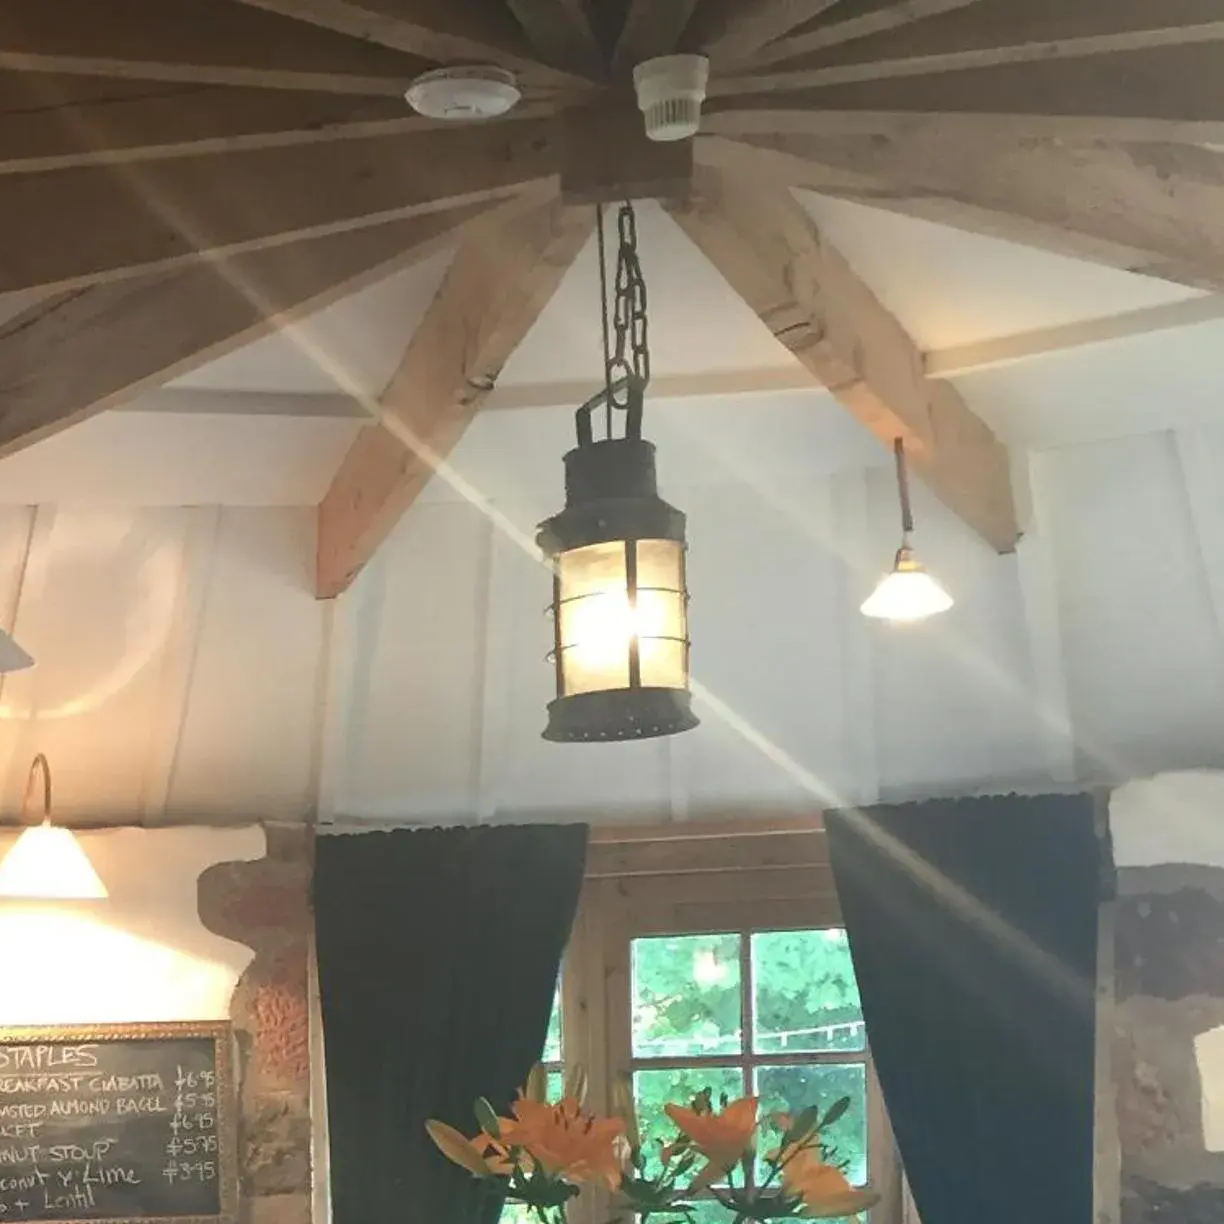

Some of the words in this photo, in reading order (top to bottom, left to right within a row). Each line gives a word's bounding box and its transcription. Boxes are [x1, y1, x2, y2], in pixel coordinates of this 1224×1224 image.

[50, 1099, 109, 1117] ALMOND
[116, 1097, 167, 1114] BAGEL
[82, 1162, 142, 1184] Lime
